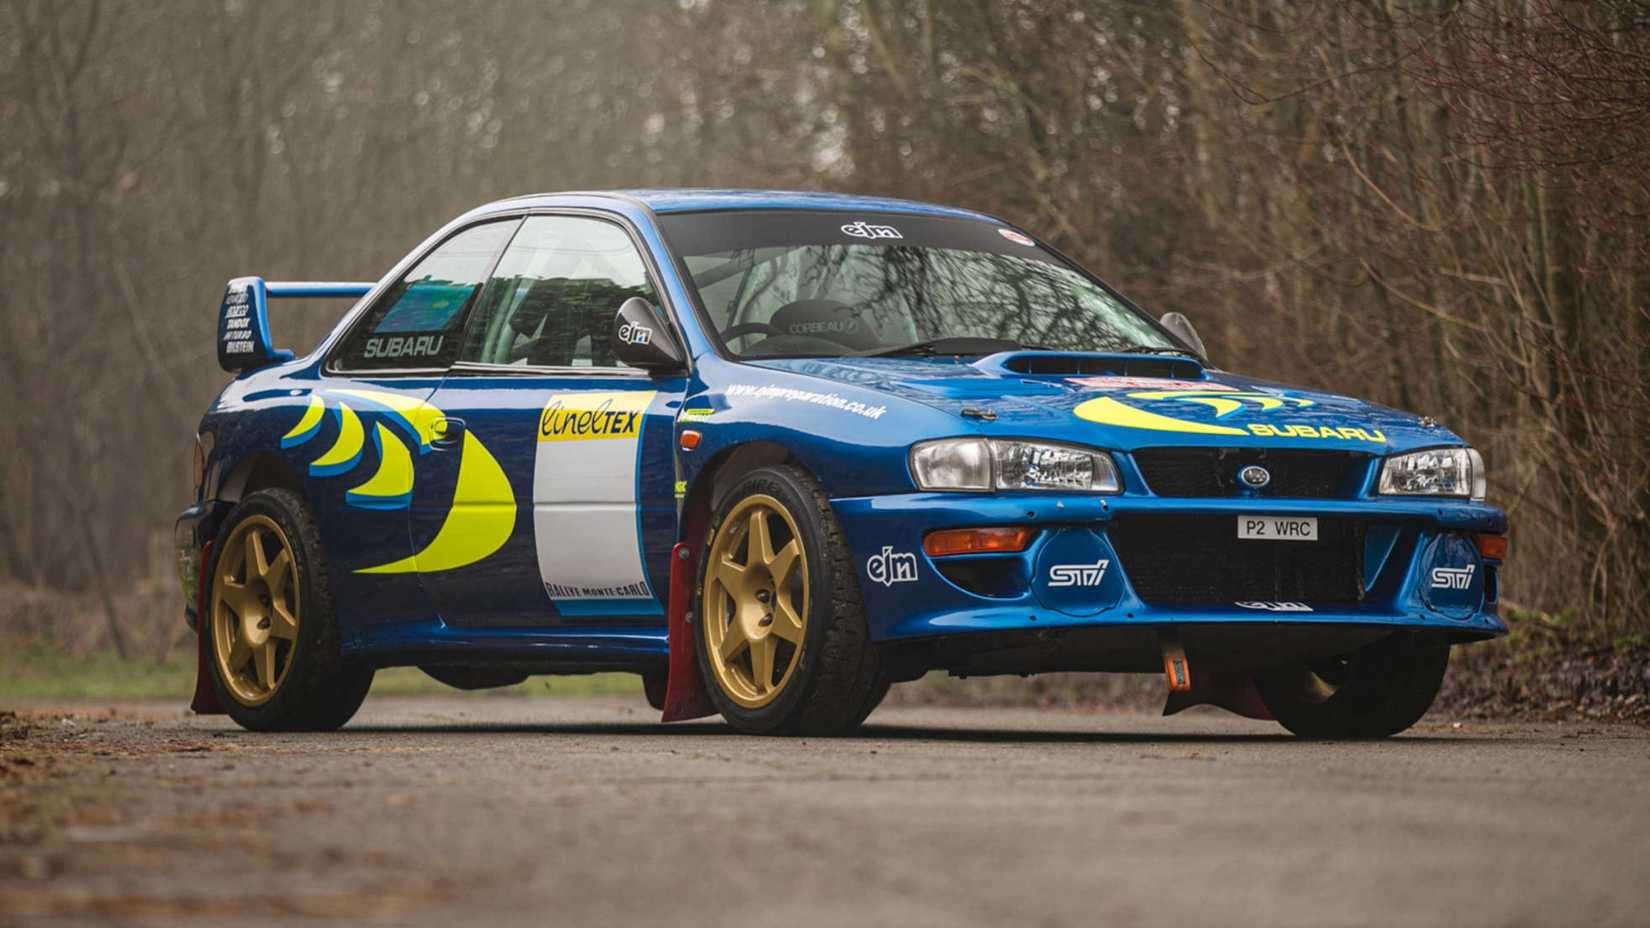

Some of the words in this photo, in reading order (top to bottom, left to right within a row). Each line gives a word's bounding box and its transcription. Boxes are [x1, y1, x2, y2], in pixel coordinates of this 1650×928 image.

[840, 221, 904, 240] ejm
[618, 320, 653, 345] ejm
[363, 335, 445, 358] SUBARU
[1247, 423, 1388, 443] SUBARU
[1246, 520, 1266, 536] P2
[1275, 521, 1312, 537] WRC
[866, 545, 919, 588] ejm
